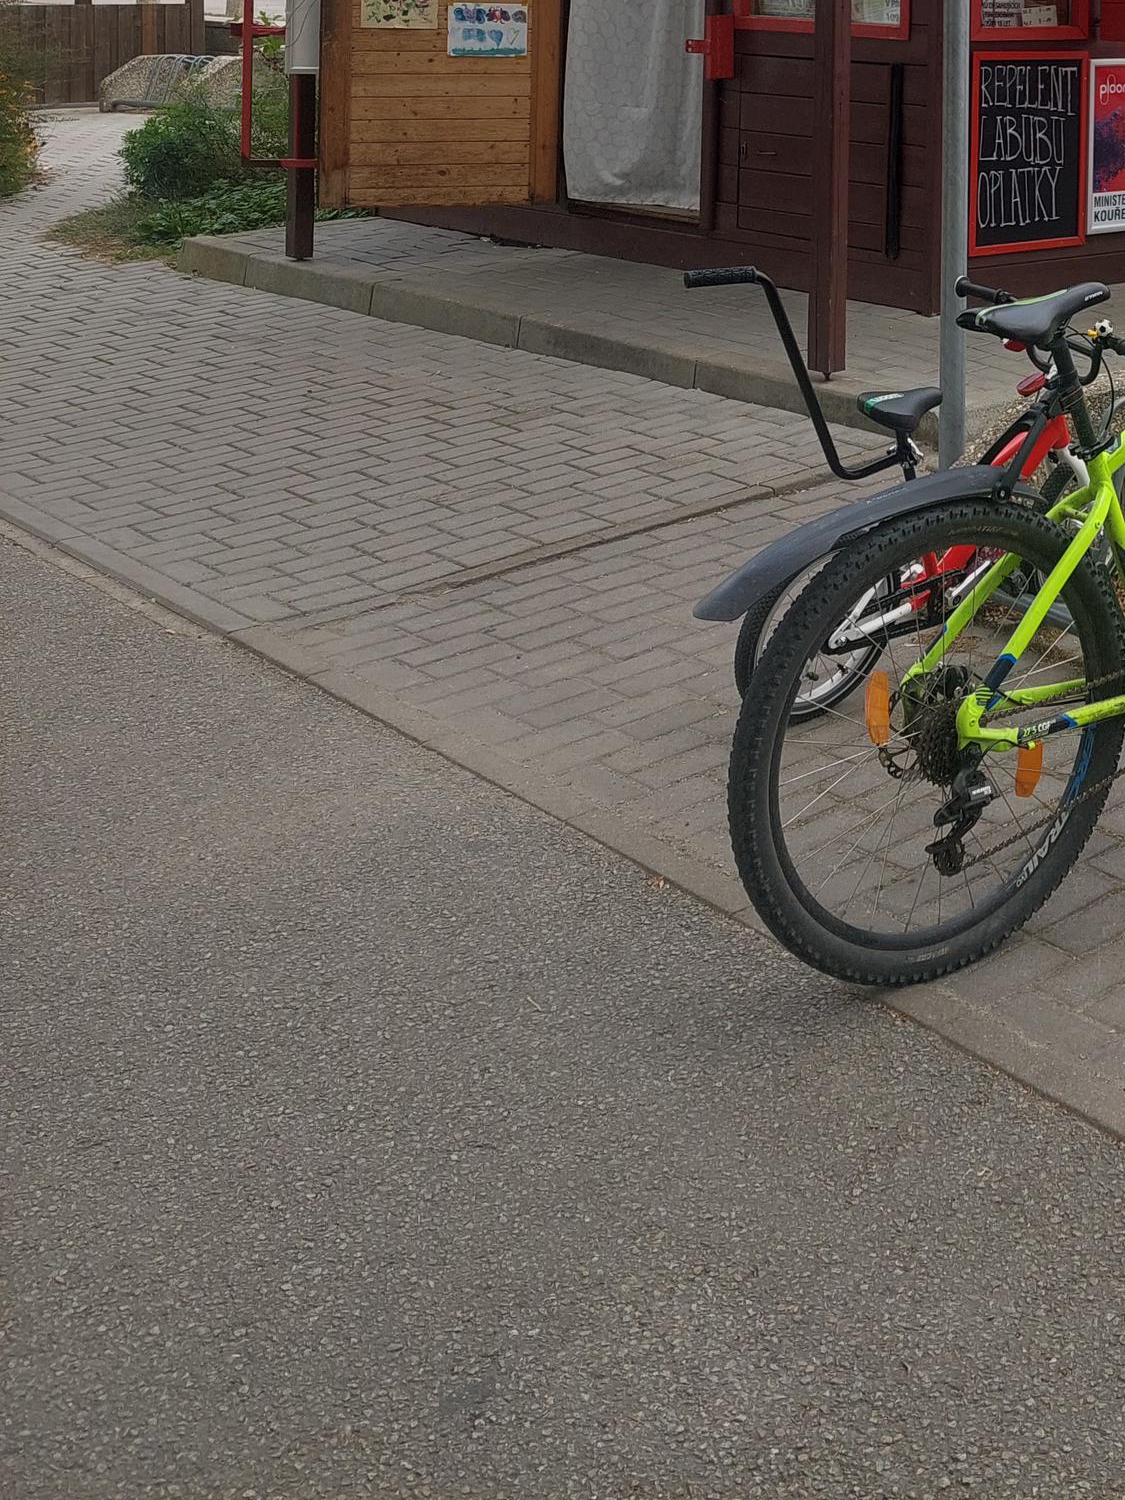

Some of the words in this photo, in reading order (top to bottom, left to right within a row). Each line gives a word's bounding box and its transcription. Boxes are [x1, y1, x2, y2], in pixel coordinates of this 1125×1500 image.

[980, 65, 1078, 116] REPELENT
[979, 114, 1066, 165] LABUBU
[977, 166, 1063, 229] OPLATKY
